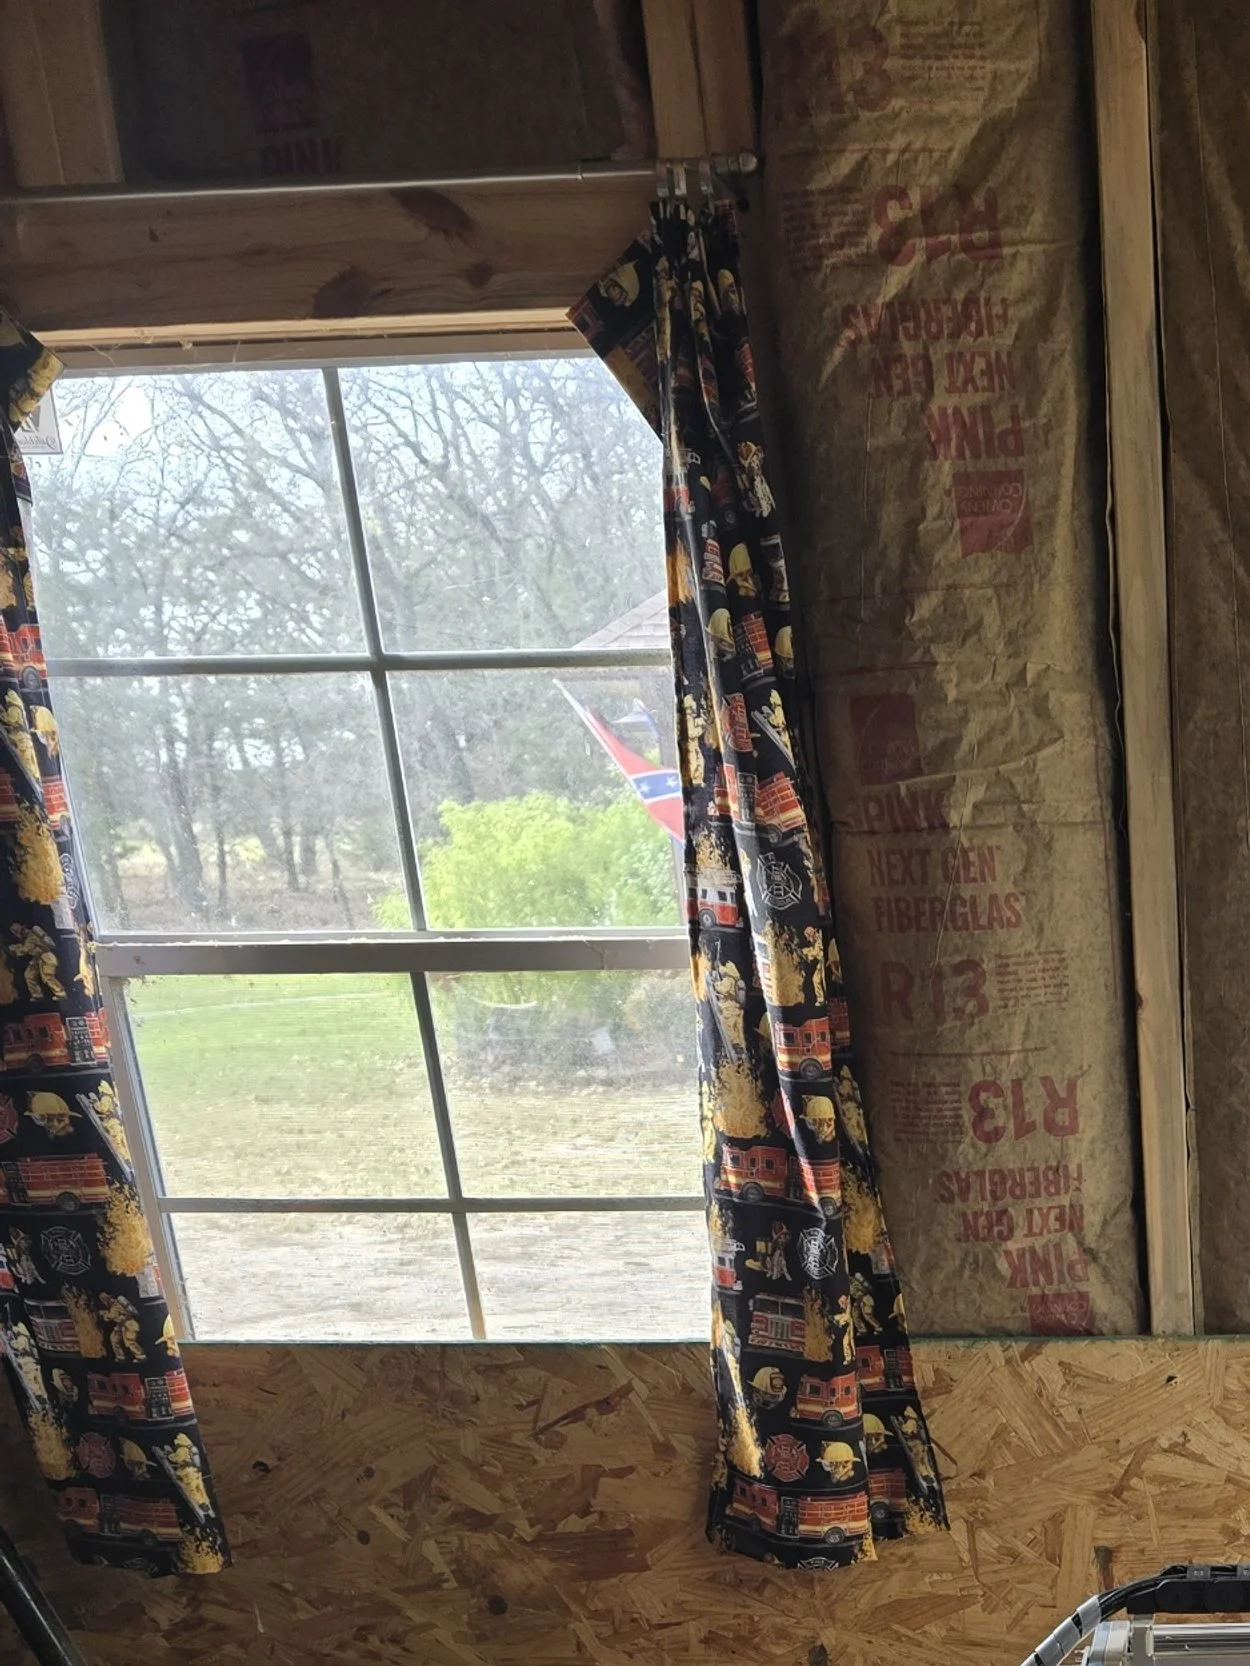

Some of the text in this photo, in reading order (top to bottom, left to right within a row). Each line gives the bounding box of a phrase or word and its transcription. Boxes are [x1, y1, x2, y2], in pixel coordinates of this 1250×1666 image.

[874, 186, 1002, 266] R13
[868, 351, 1016, 398] NEXT GEN
[925, 404, 1024, 461] PINK
[860, 788, 949, 832] PINK
[867, 846, 998, 887] NEXT GEN
[874, 892, 1024, 933] FIBERGLAS
[967, 1076, 1080, 1144] R13
[935, 1163, 1083, 1203] FIBERGLAS
[959, 1204, 1084, 1242] NEXT GEN
[1003, 1244, 1089, 1289] PINK
